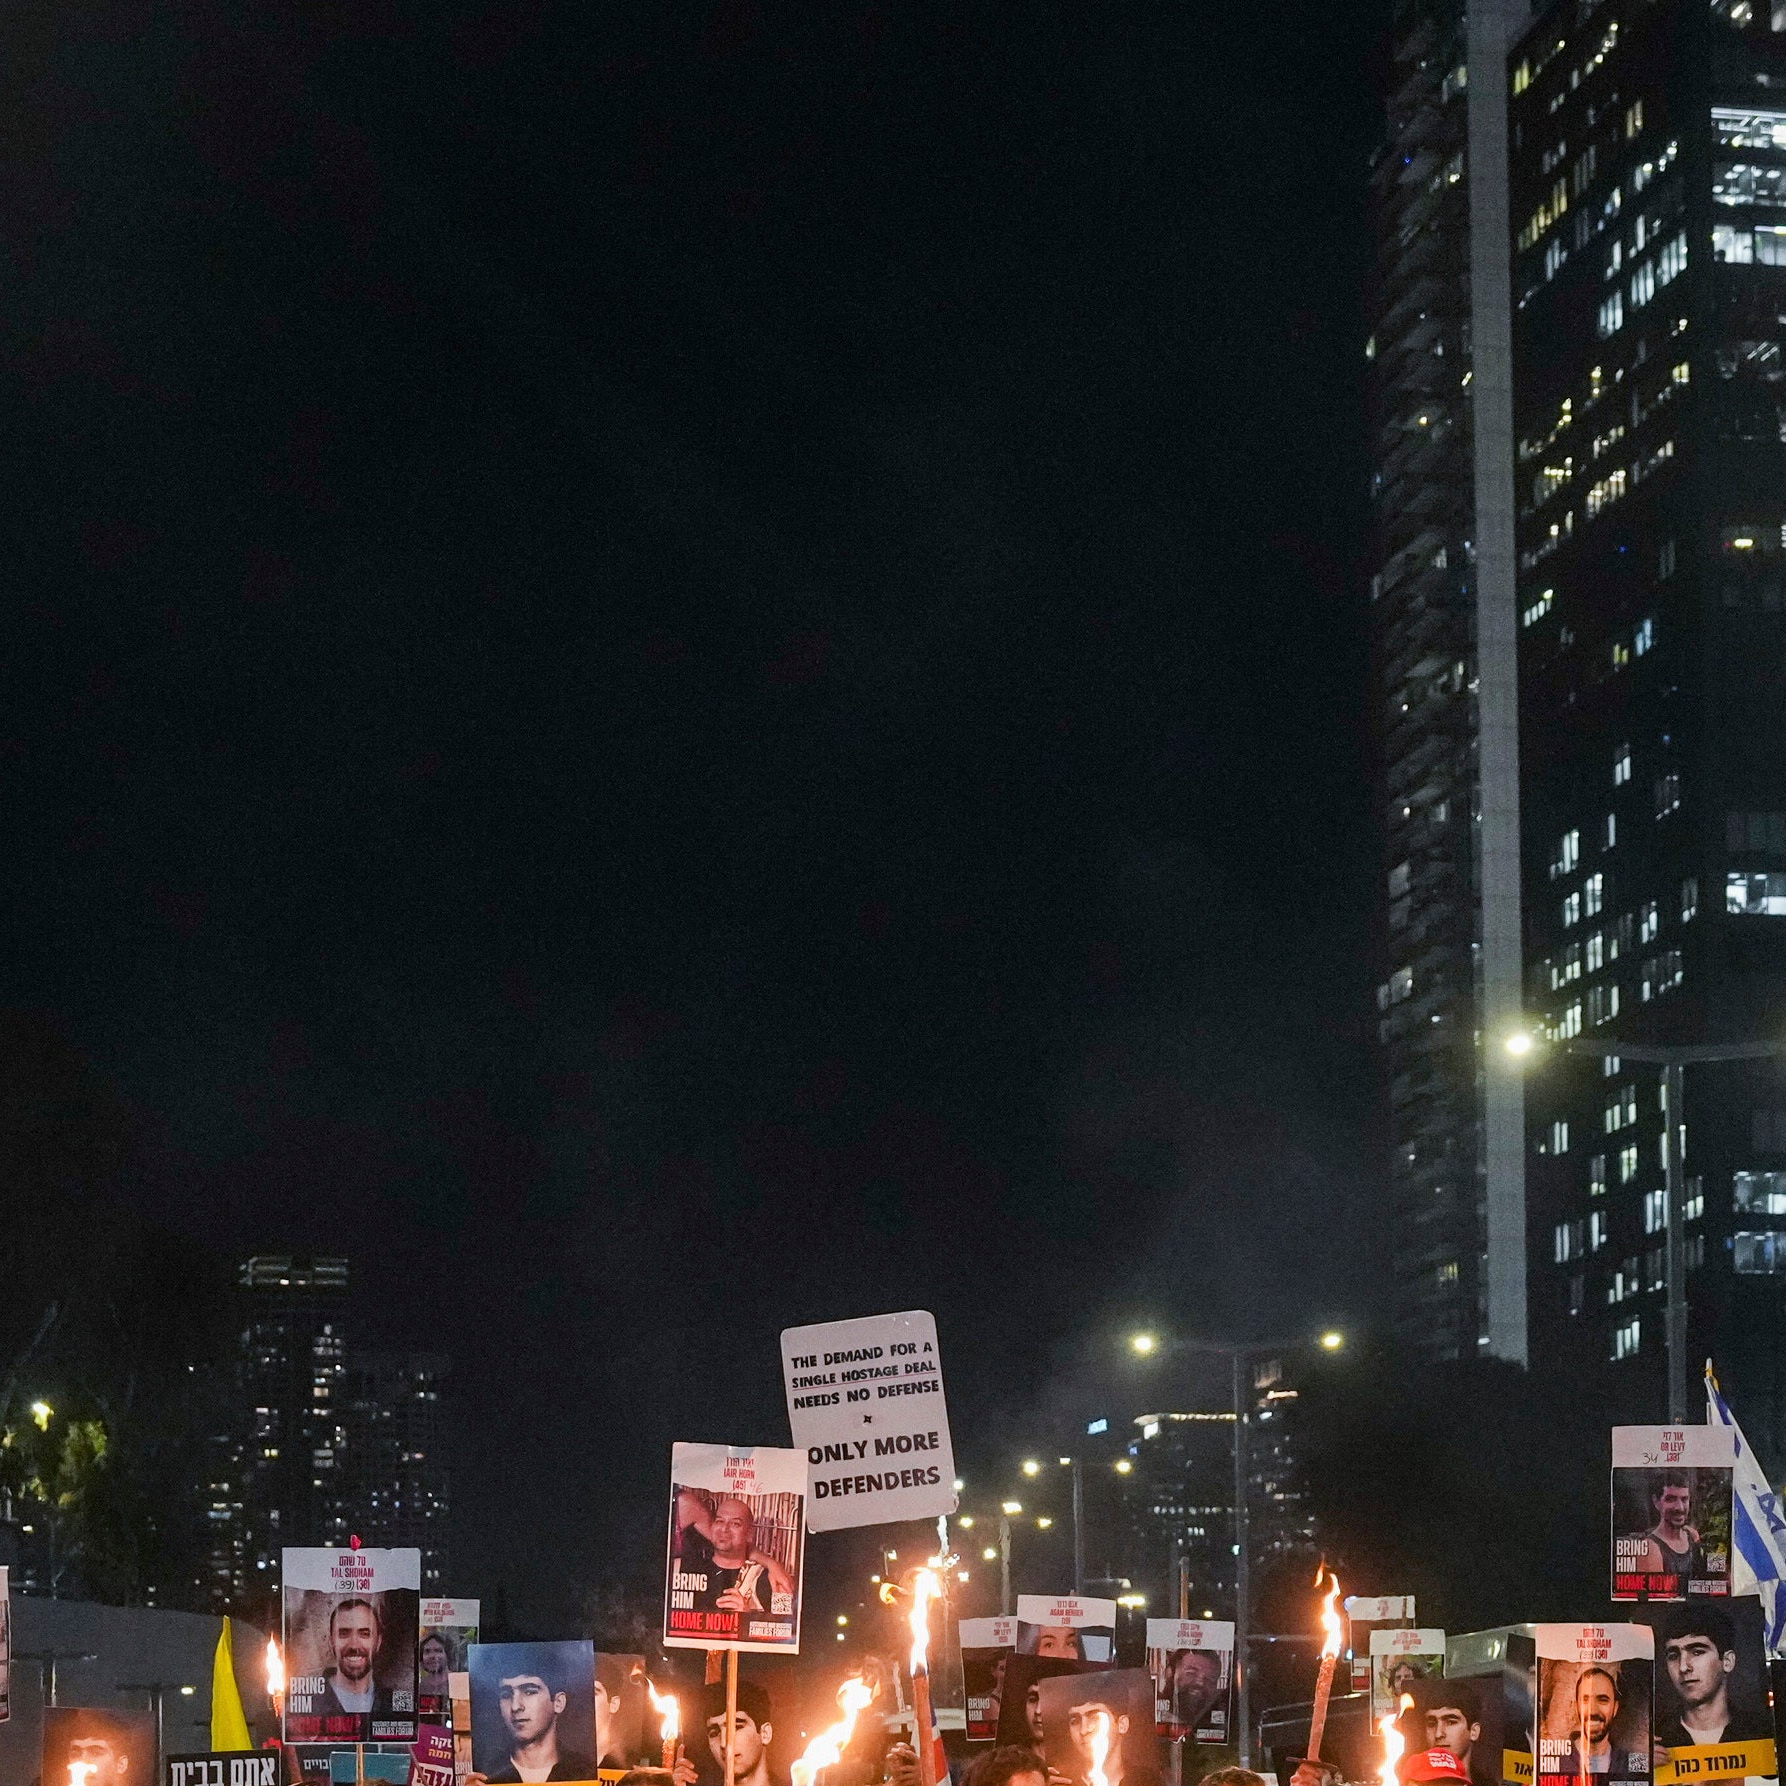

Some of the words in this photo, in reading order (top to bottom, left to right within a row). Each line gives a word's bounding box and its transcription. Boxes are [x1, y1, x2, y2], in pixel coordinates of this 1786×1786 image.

[791, 1354, 818, 1370] THE
[824, 1346, 884, 1366] DEMAND
[890, 1342, 918, 1358] FOR
[923, 1341, 933, 1353] A
[792, 1372, 837, 1389] SINGLE
[841, 1364, 900, 1383] HOSTAGE
[904, 1360, 937, 1375] DEAL
[793, 1392, 840, 1410] NEEDS
[847, 1387, 871, 1403] NO
[877, 1379, 940, 1400] DEFENSE
[808, 1439, 868, 1465] ONLY
[874, 1431, 940, 1457] MORE
[1670, 1442, 1686, 1452] LEVY
[739, 1468, 755, 1479] HORN
[814, 1465, 942, 1500] DEFENDERS
[1616, 1540, 1649, 1556] BRING
[331, 1567, 344, 1578] TAL
[345, 1567, 375, 1579] SHOHAM
[1616, 1556, 1638, 1573] HIM
[672, 1572, 708, 1592] BRING
[1616, 1574, 1646, 1591] HOME
[671, 1590, 694, 1609] HIM
[670, 1611, 704, 1630] HOME
[705, 1612, 740, 1632] NOW!
[290, 1676, 326, 1695] BRING
[289, 1694, 313, 1714] HIM
[967, 1698, 991, 1710] BRING
[1540, 1740, 1572, 1756] BRING
[230, 1757, 276, 1786] אתם
[1539, 1757, 1561, 1773] HIM
[1674, 1756, 1700, 1778] כהן
[1704, 1753, 1747, 1773] נמרוד
